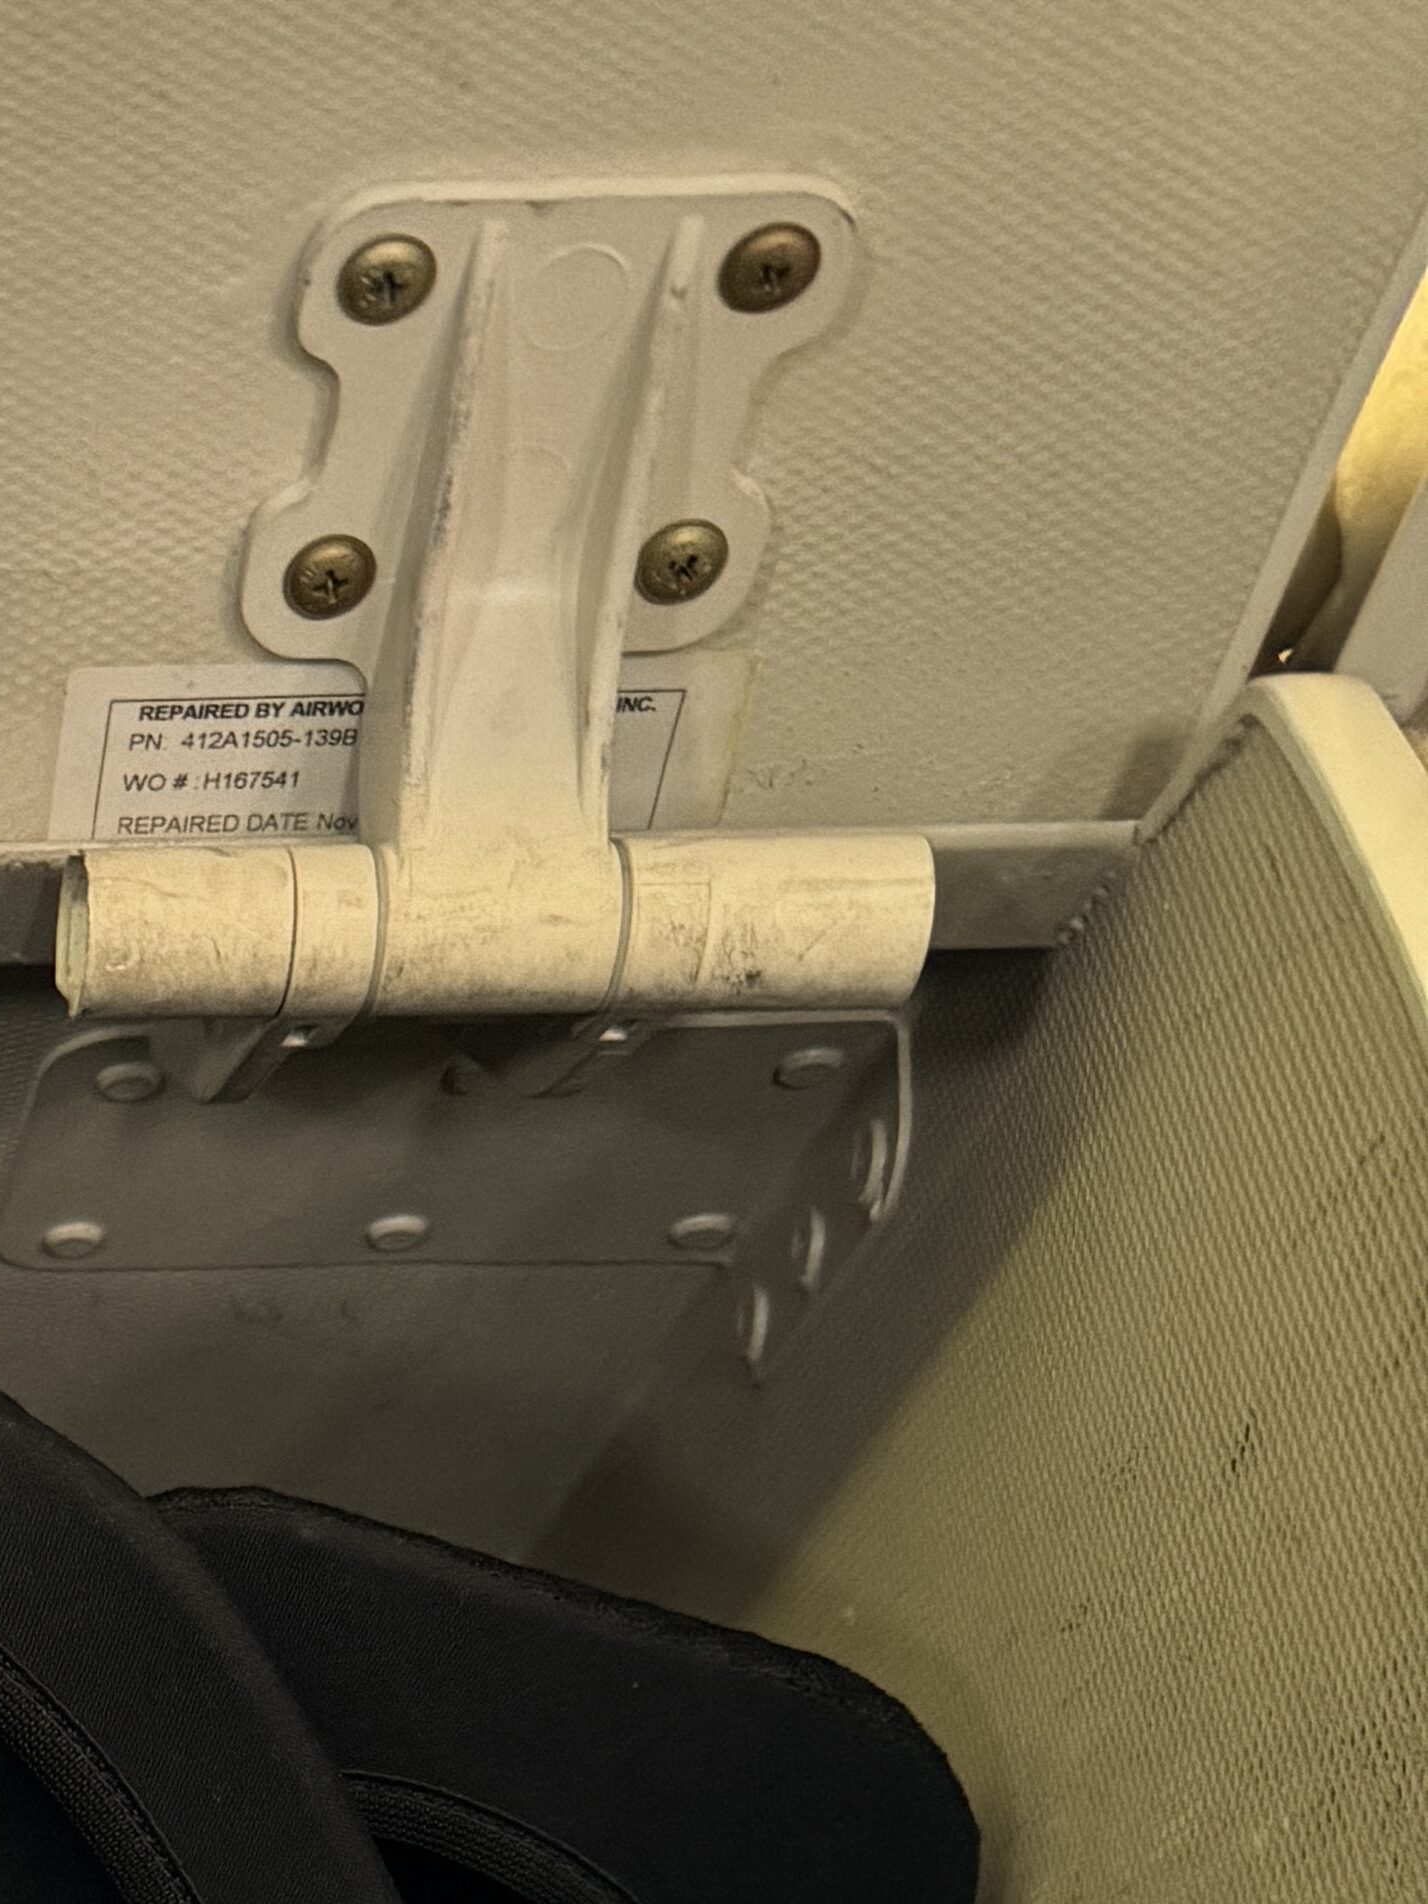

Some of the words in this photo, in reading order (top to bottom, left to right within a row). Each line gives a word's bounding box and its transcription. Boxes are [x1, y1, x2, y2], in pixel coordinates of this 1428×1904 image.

[138, 703, 250, 722] REPAIRED
[254, 701, 286, 719] BY
[615, 696, 657, 713] INC.
[123, 773, 167, 792] WO
[117, 813, 241, 835] REPAIRED
[246, 812, 309, 833] DATE
